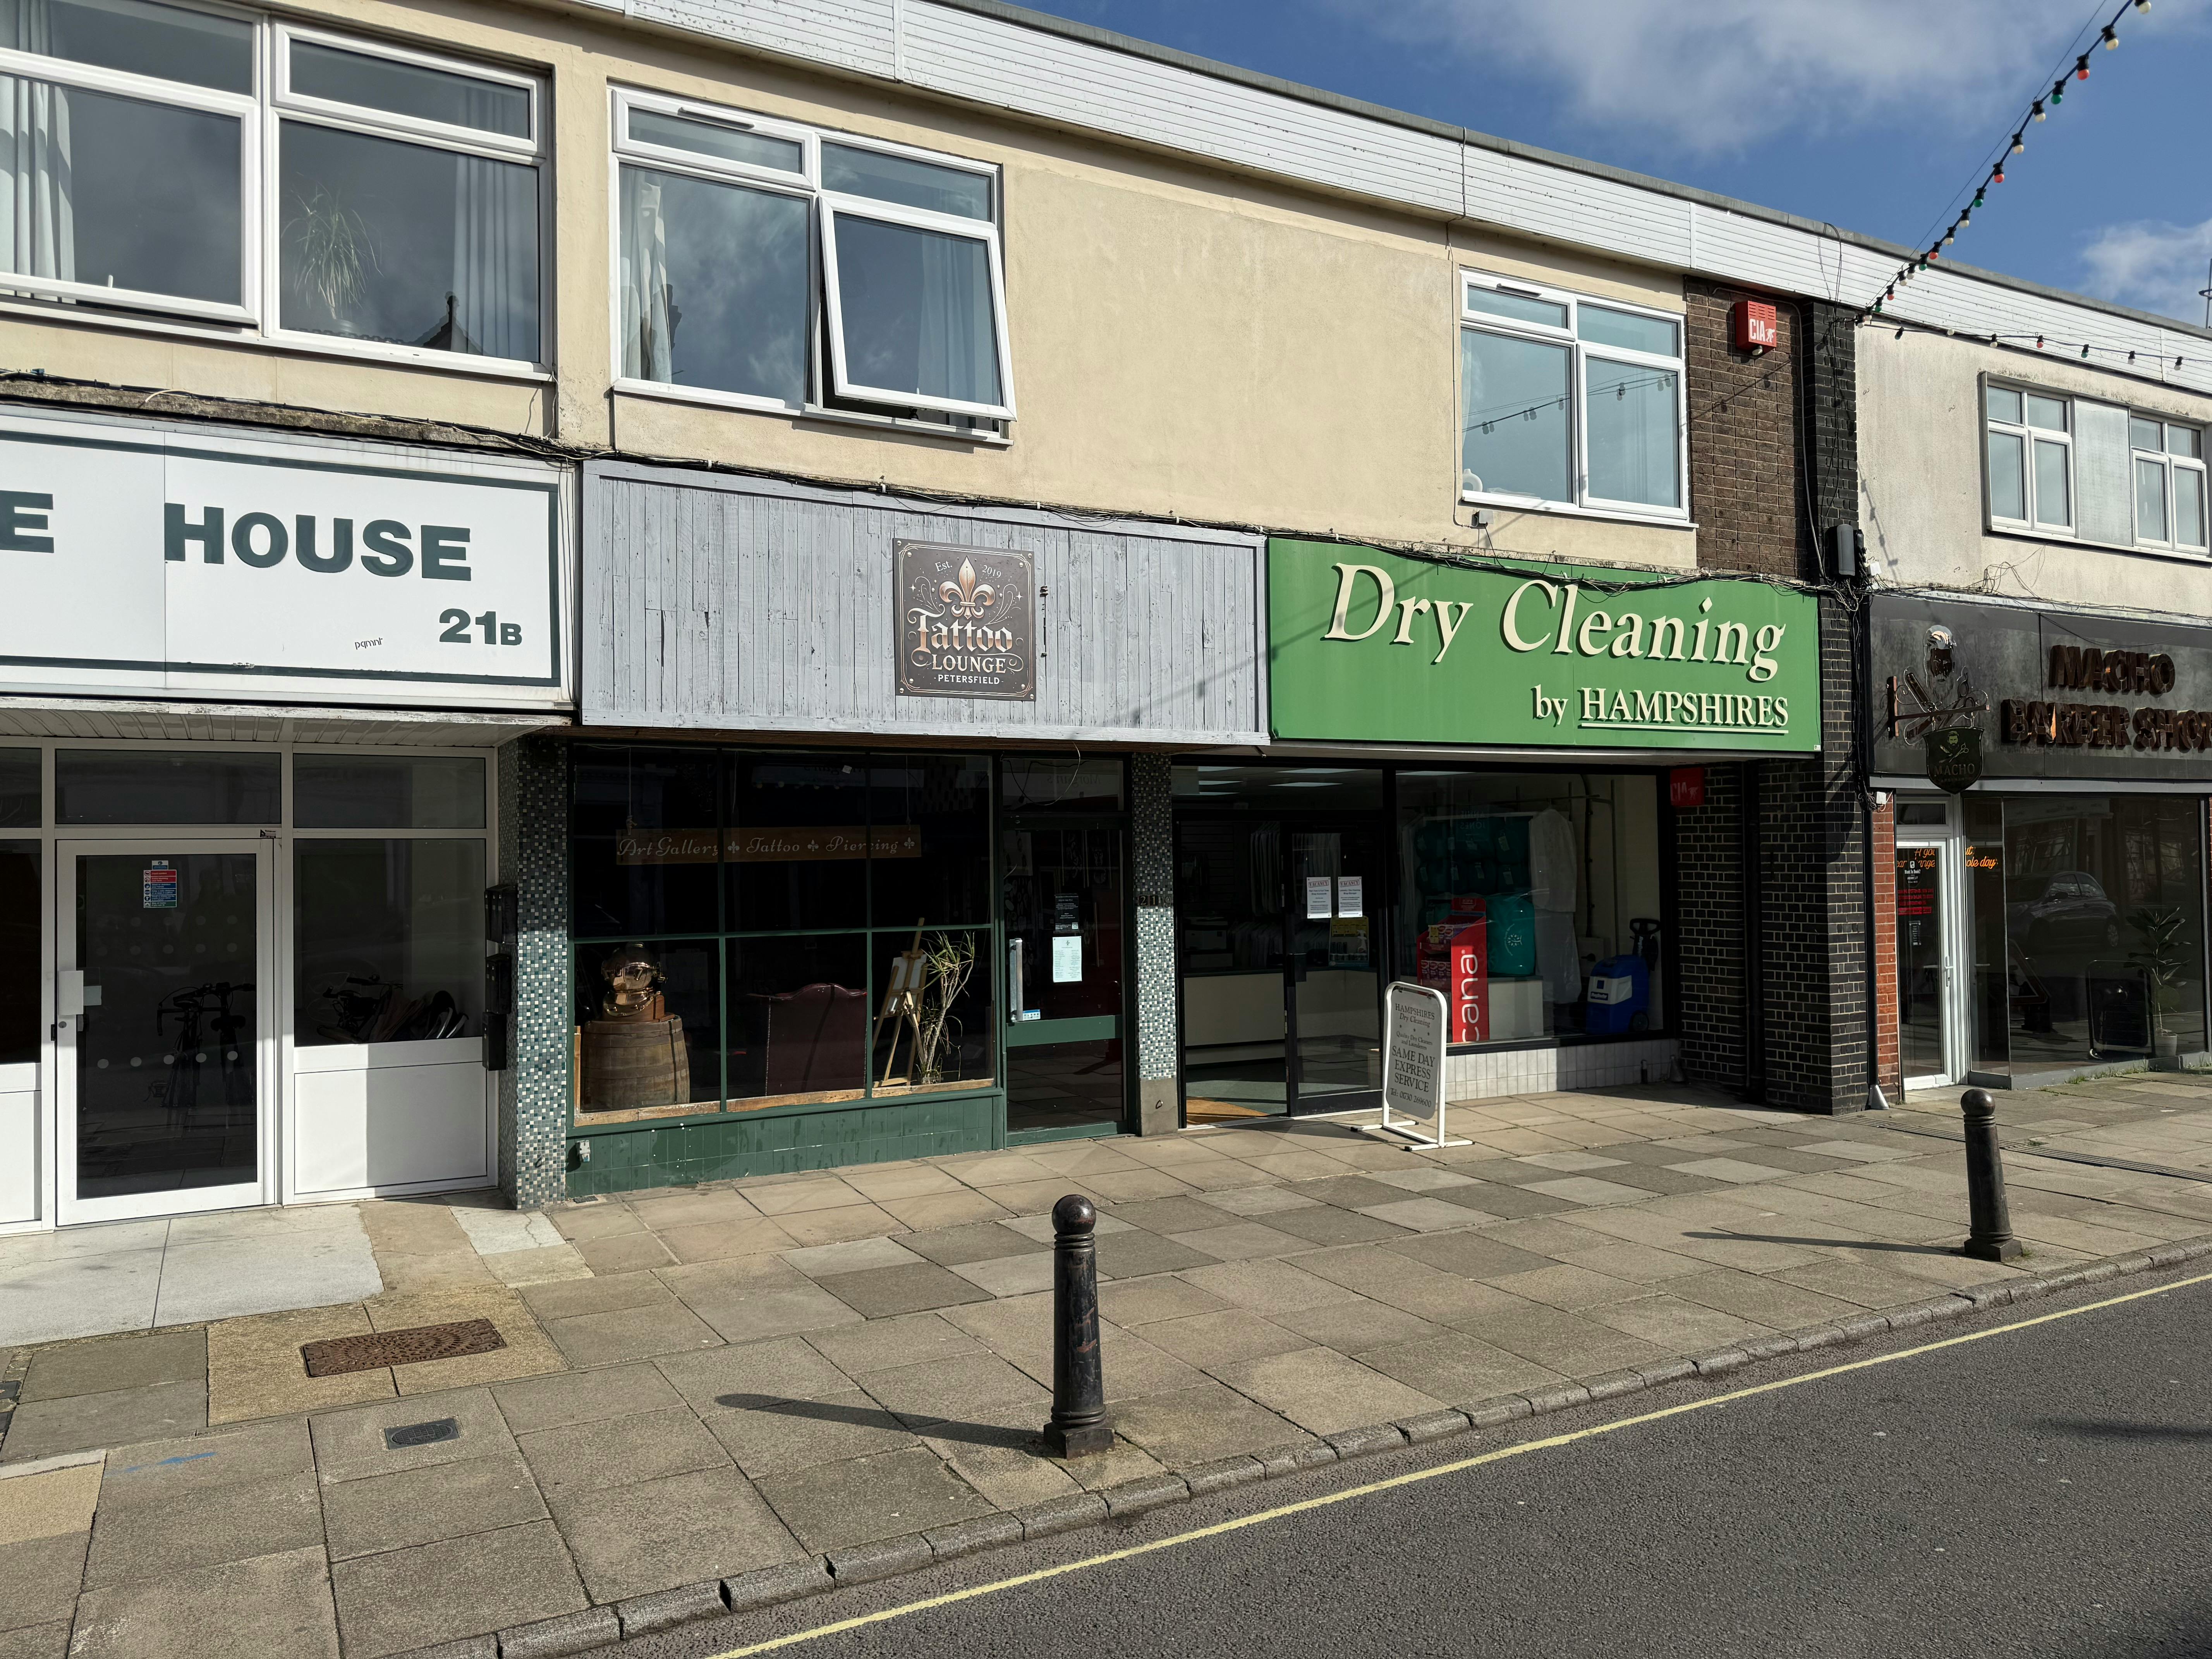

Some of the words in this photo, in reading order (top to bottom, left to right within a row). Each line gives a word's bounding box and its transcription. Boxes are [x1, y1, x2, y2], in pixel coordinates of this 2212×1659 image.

[1750, 318, 1765, 342] CIA
[164, 502, 472, 581] HOUSE
[935, 560, 952, 572] Est.
[982, 565, 1001, 578] 2019
[439, 608, 522, 646] 21B
[907, 604, 1013, 653] Tattoo
[1324, 562, 1474, 665] Dry
[1502, 579, 1786, 682] Cleaning
[932, 654, 1006, 673] LOUNGE
[2049, 644, 2175, 694] MACHO
[1533, 684, 1568, 726] by
[1581, 687, 1788, 727] HAMPSHIRES
[2001, 699, 2131, 748] BARBER
[617, 838, 653, 856] Art
[656, 836, 719, 857] Gallery
[746, 837, 800, 853] Tattoo
[1140, 896, 1156, 905] 21
[1395, 1003, 1435, 1020] HAMPSHIRES
[1400, 1013, 1408, 1022] Dry
[1410, 1016, 1431, 1028] Cleaning
[1392, 1046, 1415, 1061] SAME
[1418, 1053, 1436, 1067] DAY
[1395, 1059, 1431, 1079] EXPRESS
[1395, 1072, 1429, 1092] SERVICE
[1390, 1088, 1398, 1096] Tel:
[1400, 1091, 1412, 1101] 01730
[1413, 1096, 1432, 1107] 269600
